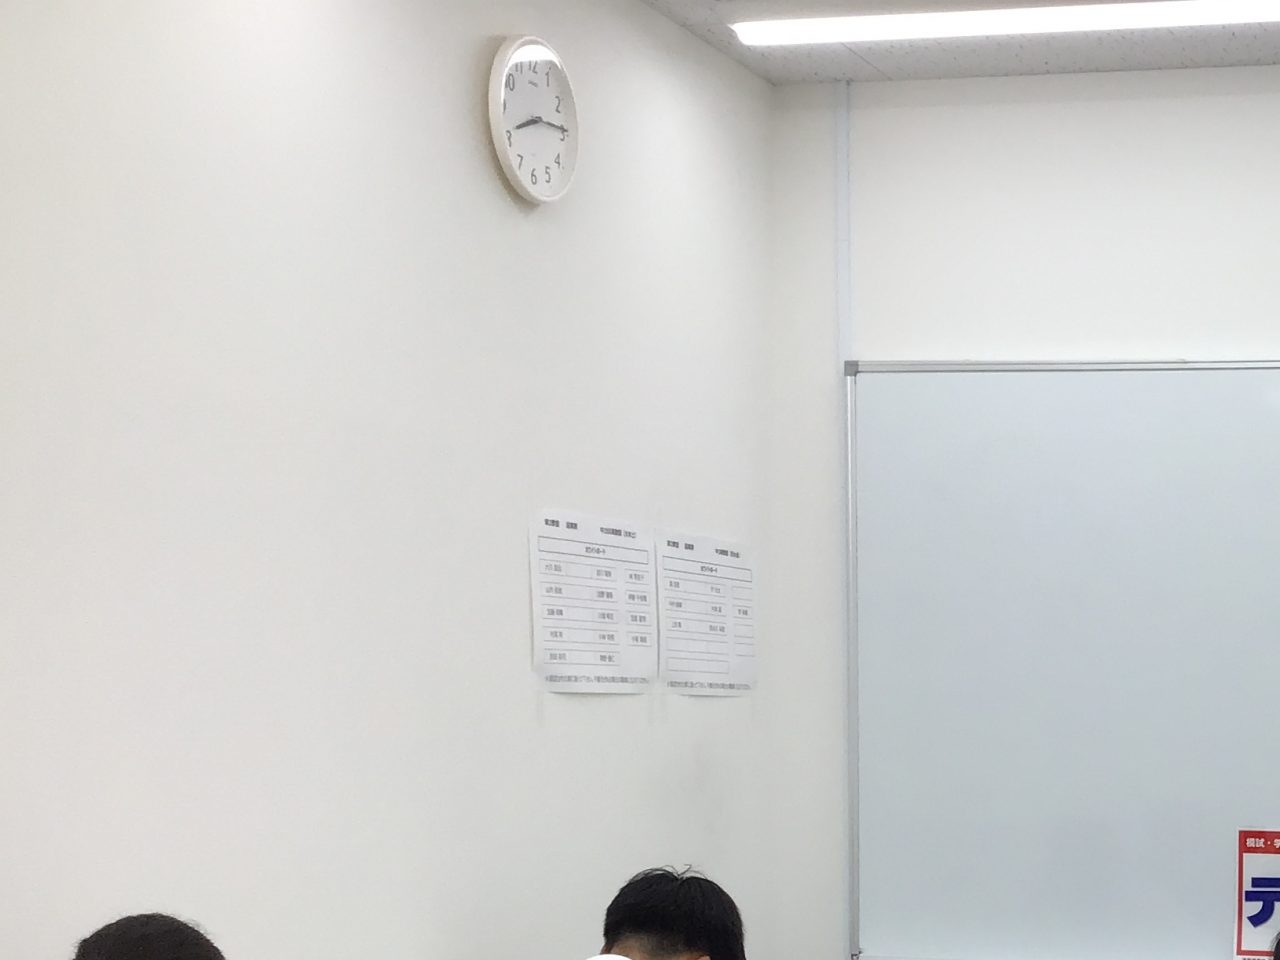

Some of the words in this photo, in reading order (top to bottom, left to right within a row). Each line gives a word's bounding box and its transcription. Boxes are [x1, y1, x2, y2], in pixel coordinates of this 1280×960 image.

[555, 95, 561, 114] 2
[517, 154, 524, 170] 7
[554, 153, 561, 168] 4
[530, 168, 538, 185] 6
[544, 166, 551, 183] 5
